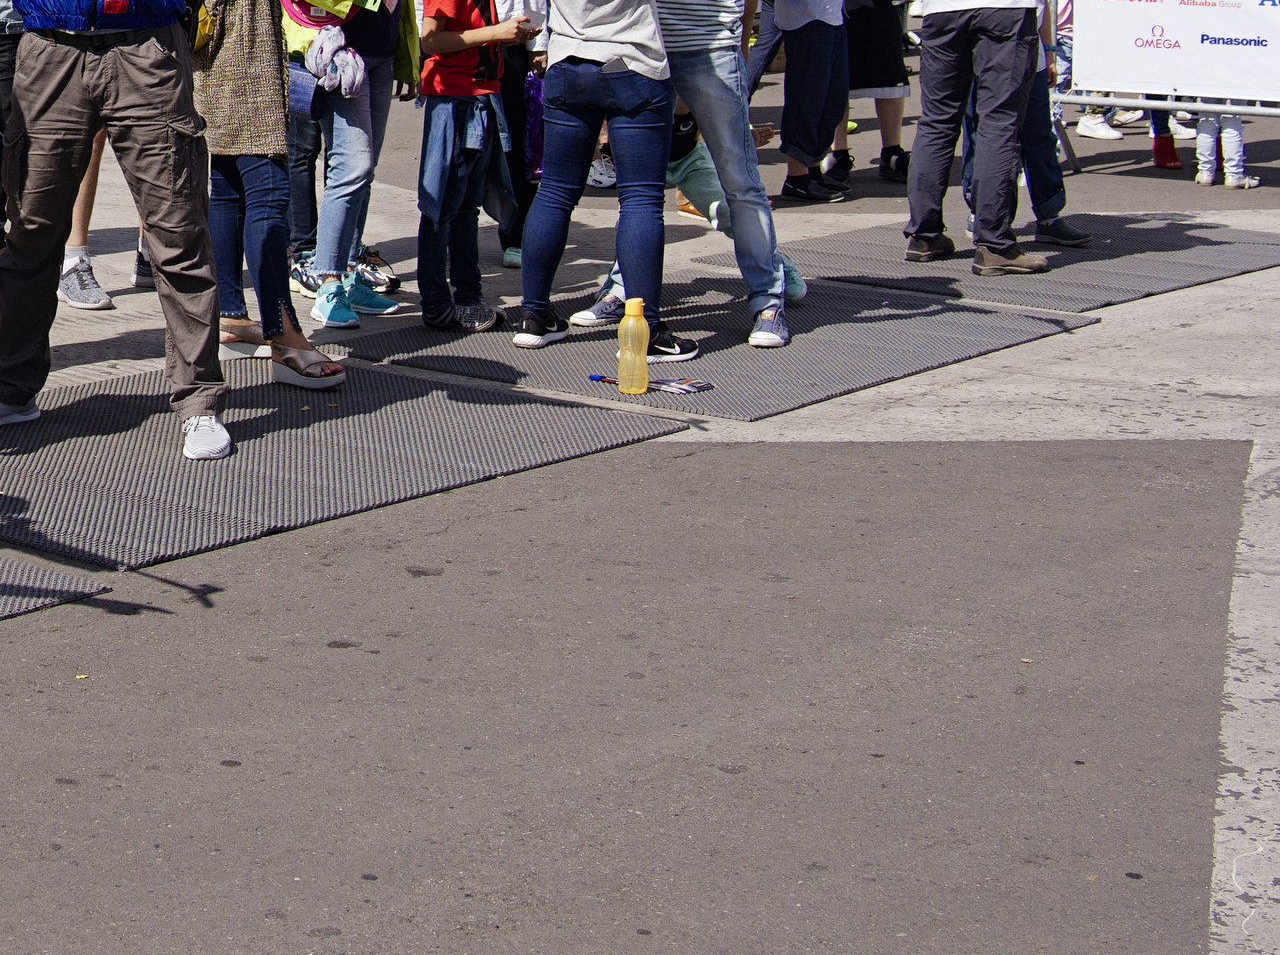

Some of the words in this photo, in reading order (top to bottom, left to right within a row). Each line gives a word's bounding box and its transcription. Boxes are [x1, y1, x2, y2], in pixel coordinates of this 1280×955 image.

[1218, 0, 1242, 9] Group
[1134, 37, 1182, 50] OMEGA
[1200, 33, 1268, 47] Panasonic
